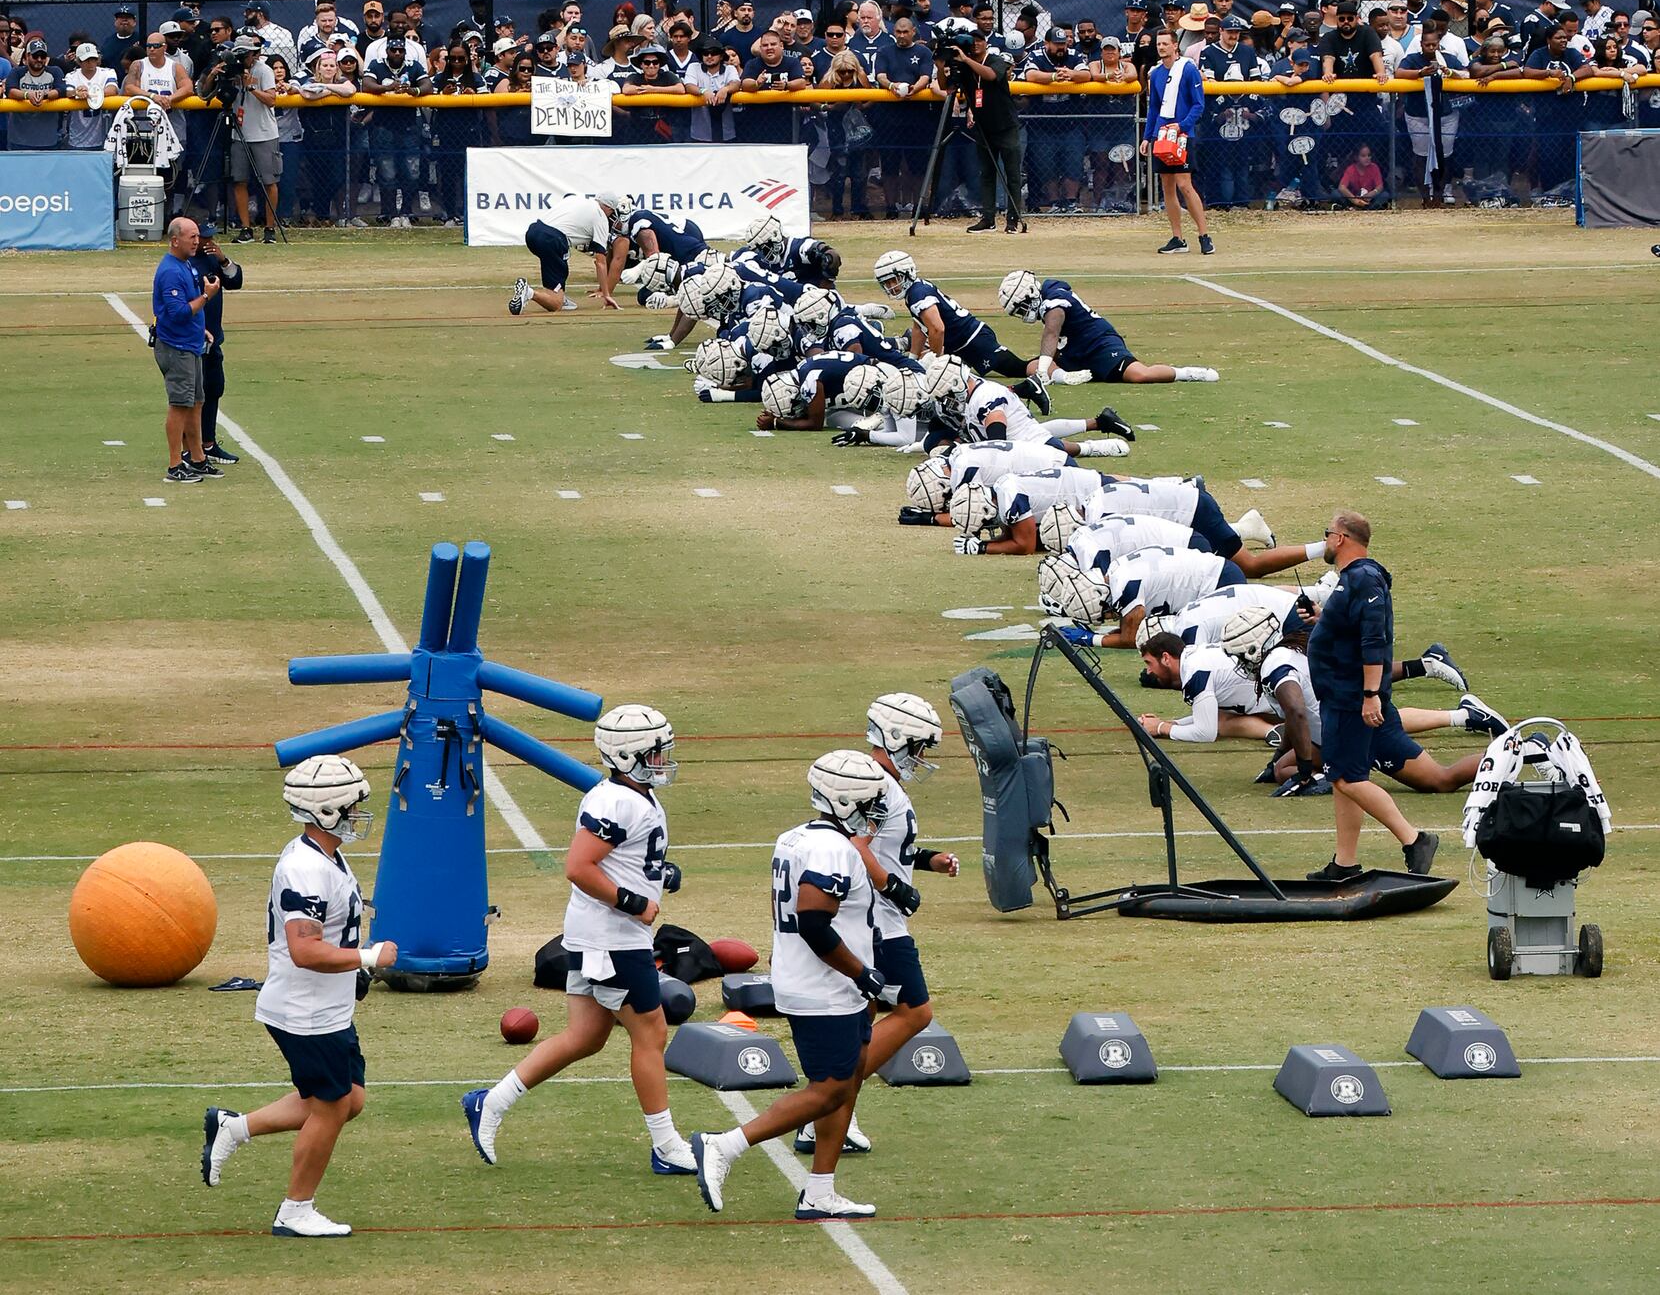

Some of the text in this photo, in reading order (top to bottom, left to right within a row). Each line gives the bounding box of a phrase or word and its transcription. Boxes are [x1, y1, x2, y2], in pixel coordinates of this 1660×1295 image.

[535, 106, 607, 130] DEM BOYS
[476, 192, 734, 210] BANK MERICA
[130, 217, 154, 225] COWBOYS
